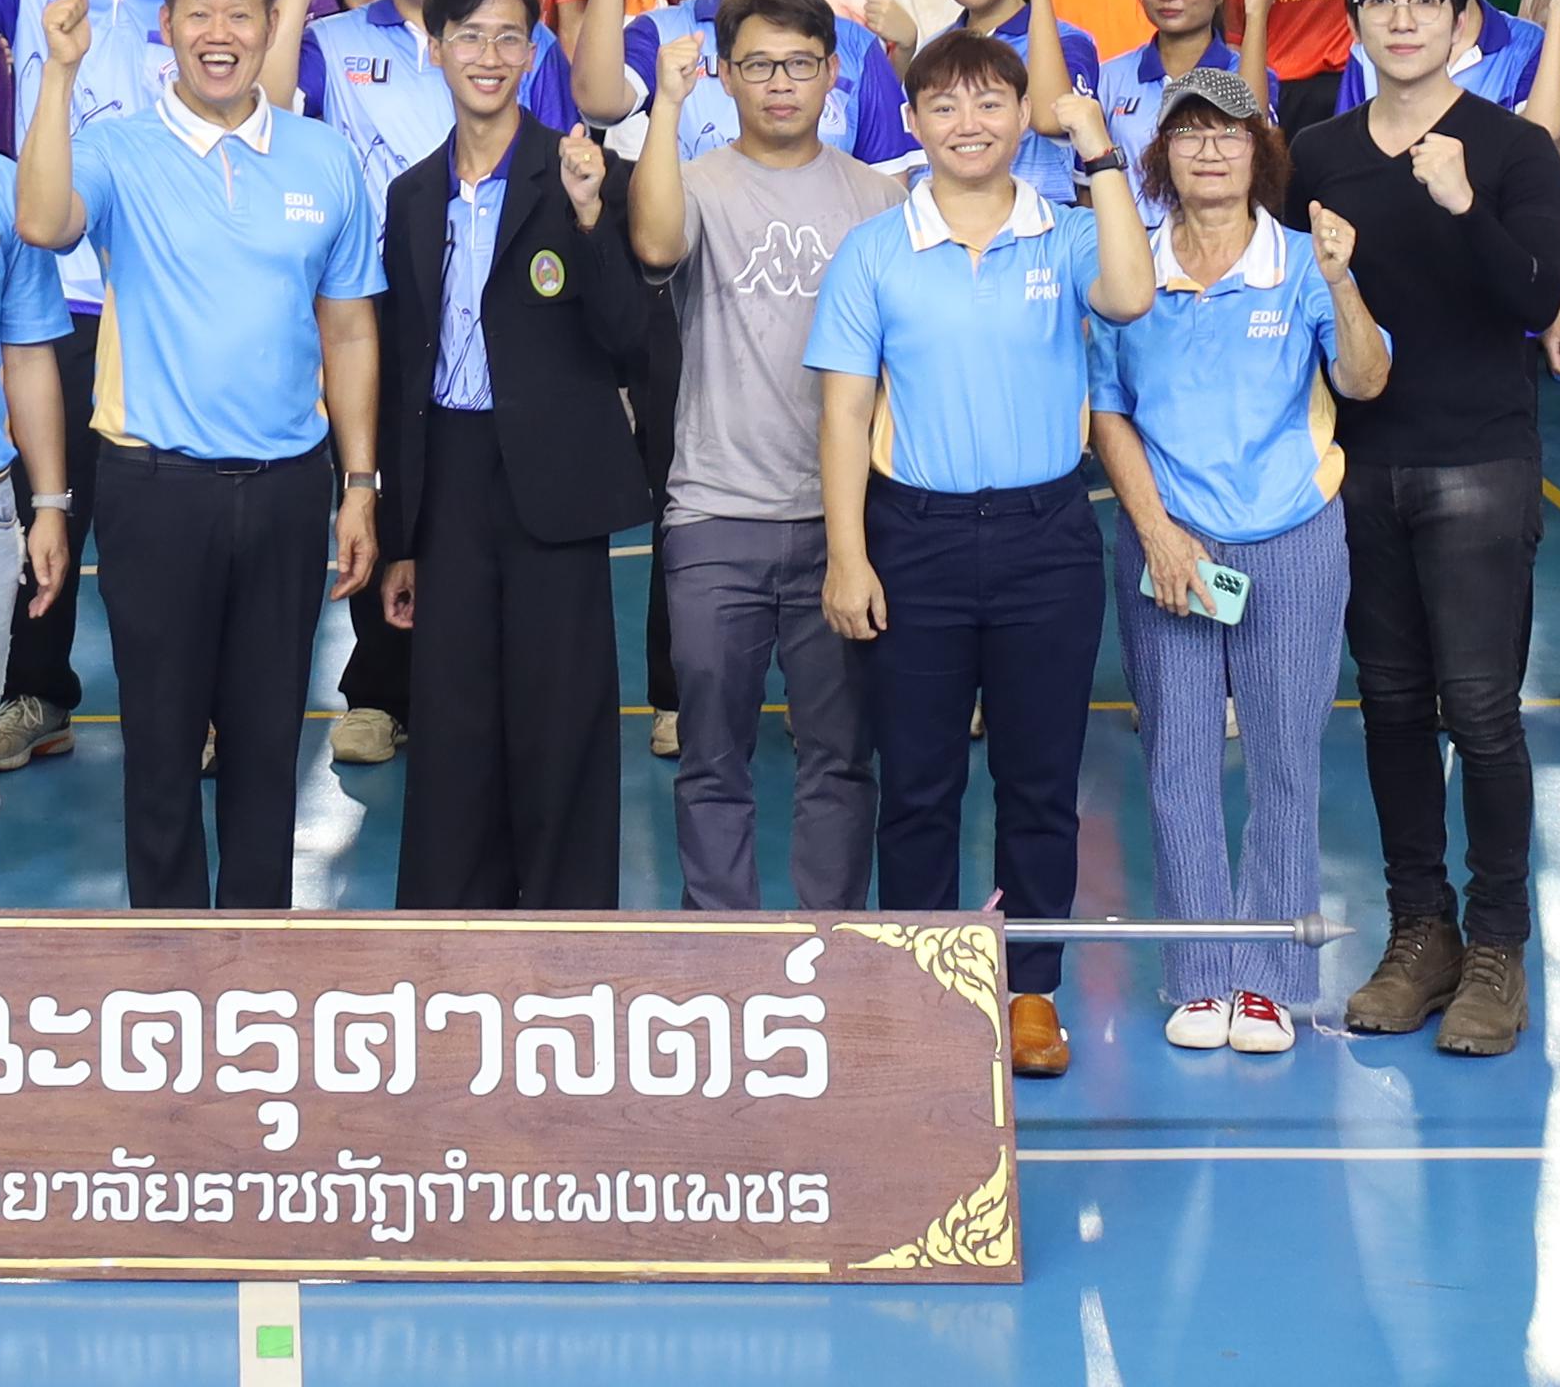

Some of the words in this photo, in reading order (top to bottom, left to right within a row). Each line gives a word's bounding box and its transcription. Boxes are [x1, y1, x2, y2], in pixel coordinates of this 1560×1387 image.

[284, 192, 314, 207] EDU
[285, 207, 325, 224] KPRU
[1026, 267, 1052, 284] EDU
[1025, 283, 1061, 300] KPRU
[1249, 310, 1284, 325] EDU
[1247, 323, 1291, 339] KPRU
